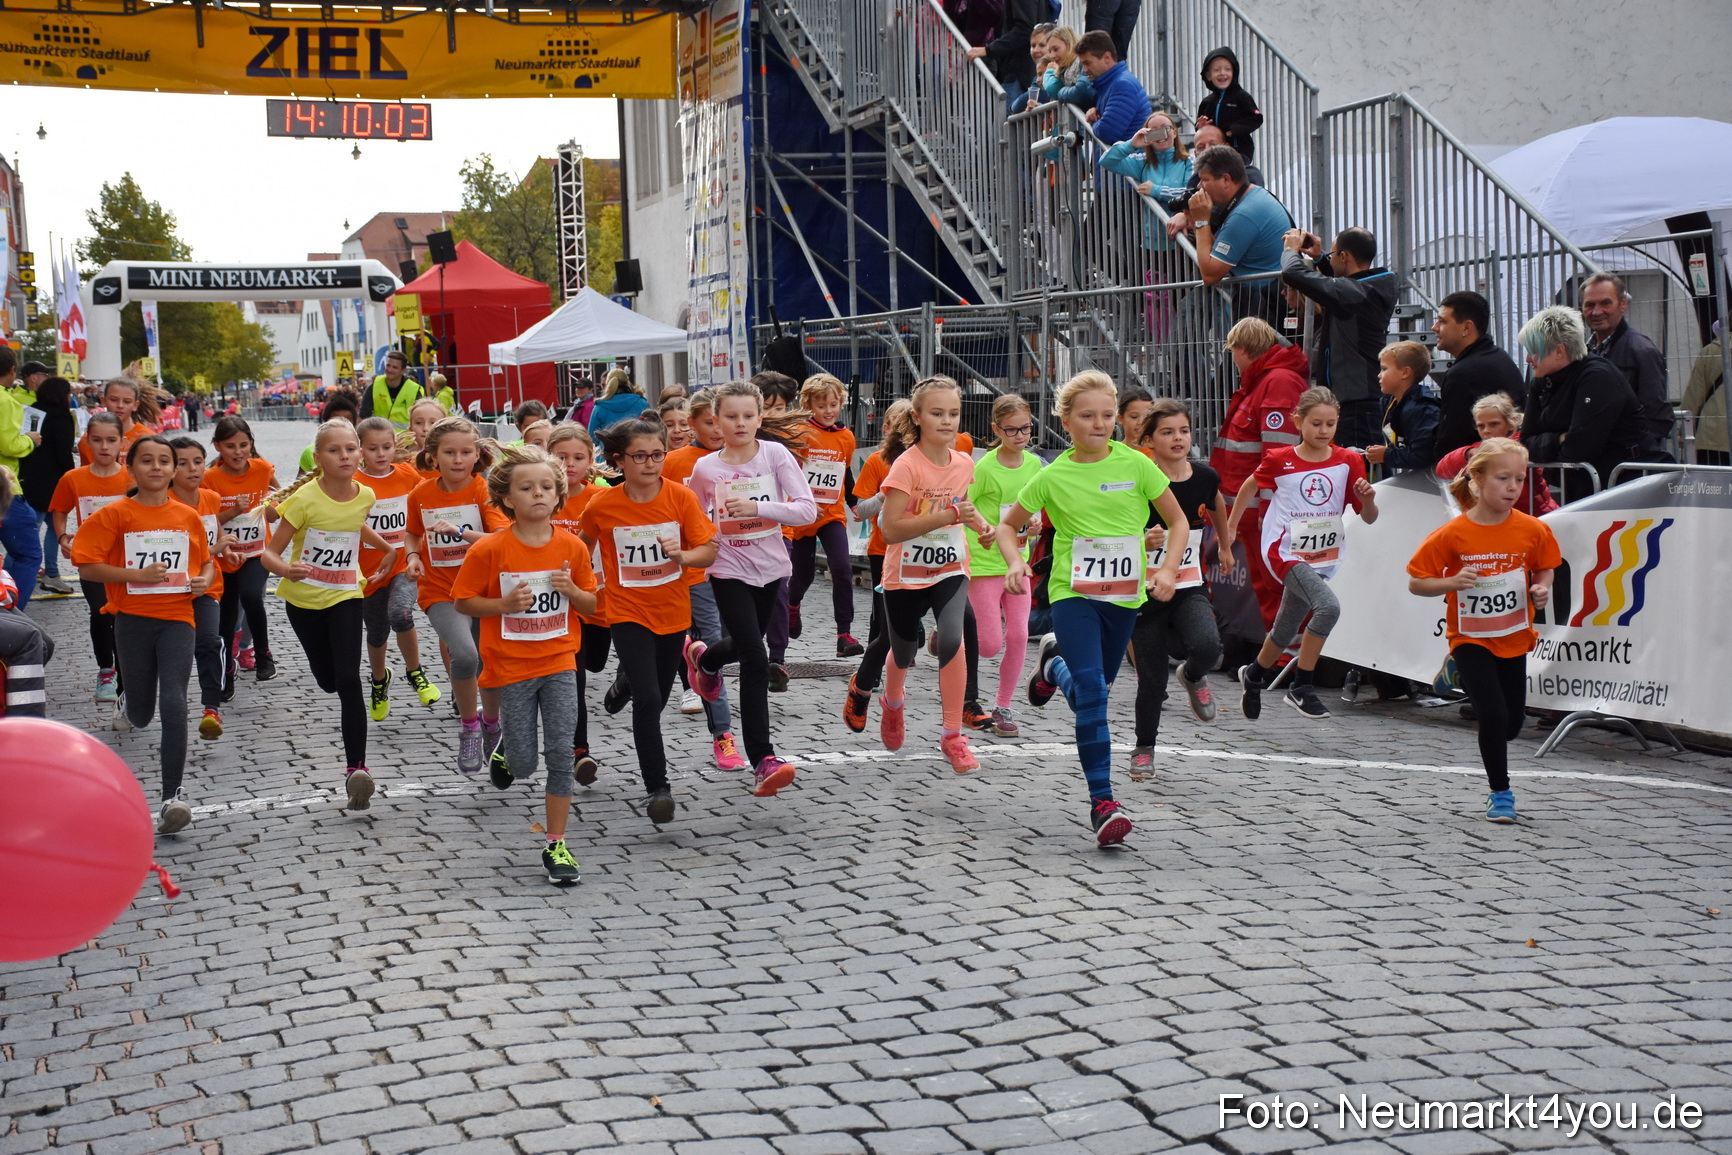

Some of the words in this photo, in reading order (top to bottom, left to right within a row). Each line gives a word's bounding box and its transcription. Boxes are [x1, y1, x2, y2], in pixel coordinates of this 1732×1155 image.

[80, 47, 151, 61] Stadtlauf
[246, 26, 408, 80] ZIEL
[494, 57, 576, 70] Neumarkter
[580, 57, 641, 69] Stadtlauf
[148, 269, 204, 287] MINI
[209, 268, 342, 287] NEUMARKT.
[63, 361, 74, 374] A
[145, 362, 152, 371] B
[340, 359, 350, 371] A
[366, 360, 373, 368] B
[808, 471, 837, 487] 7145
[1698, 482, 1722, 495] Wasser
[370, 511, 406, 530] 7000
[740, 521, 762, 530] Sophia
[224, 527, 259, 541] 7173
[1300, 532, 1337, 550] 7118
[136, 551, 181, 569] 7167
[312, 547, 352, 567] 7244
[443, 549, 467, 557] Victoria
[912, 545, 957, 565] 7086
[1154, 548, 1192, 565] 72
[309, 568, 347, 583] ALINA
[641, 568, 662, 576] Emilia
[1083, 557, 1132, 578] 7110
[1467, 591, 1517, 614] 7393
[511, 612, 566, 633] JOHANNA
[1532, 637, 1632, 664] neumarkt
[1538, 674, 1669, 707] lebensqualität!
